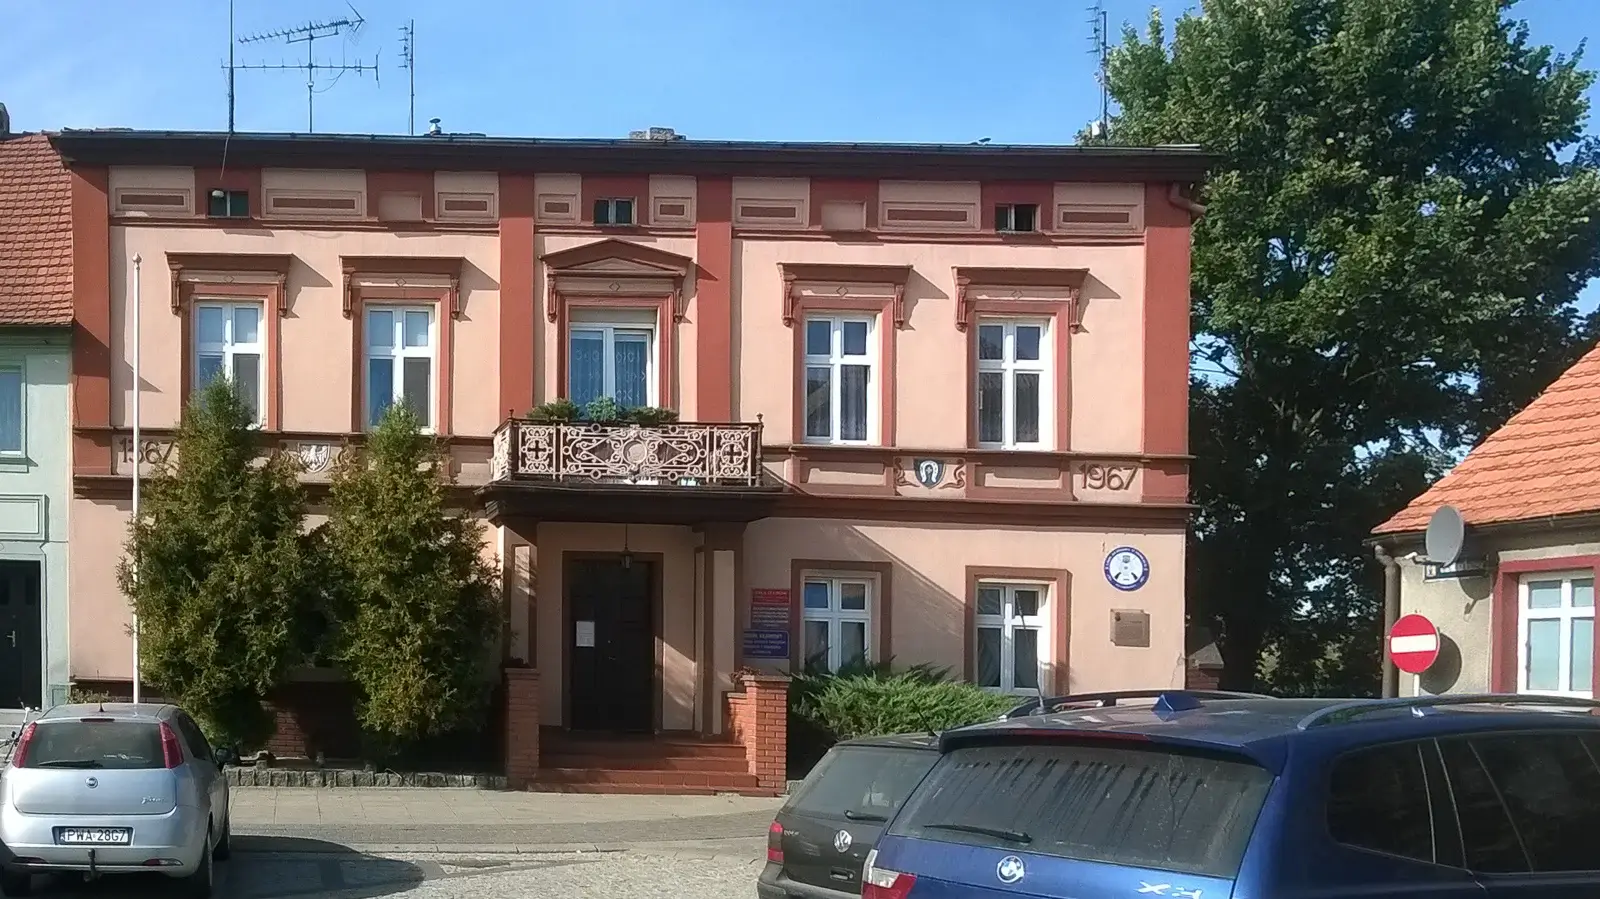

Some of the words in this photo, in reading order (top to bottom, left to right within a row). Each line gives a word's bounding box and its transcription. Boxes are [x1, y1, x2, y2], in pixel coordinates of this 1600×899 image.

[1079, 462, 1139, 490] 1967
[67, 829, 93, 841] PWA
[97, 829, 126, 841] 28G7
